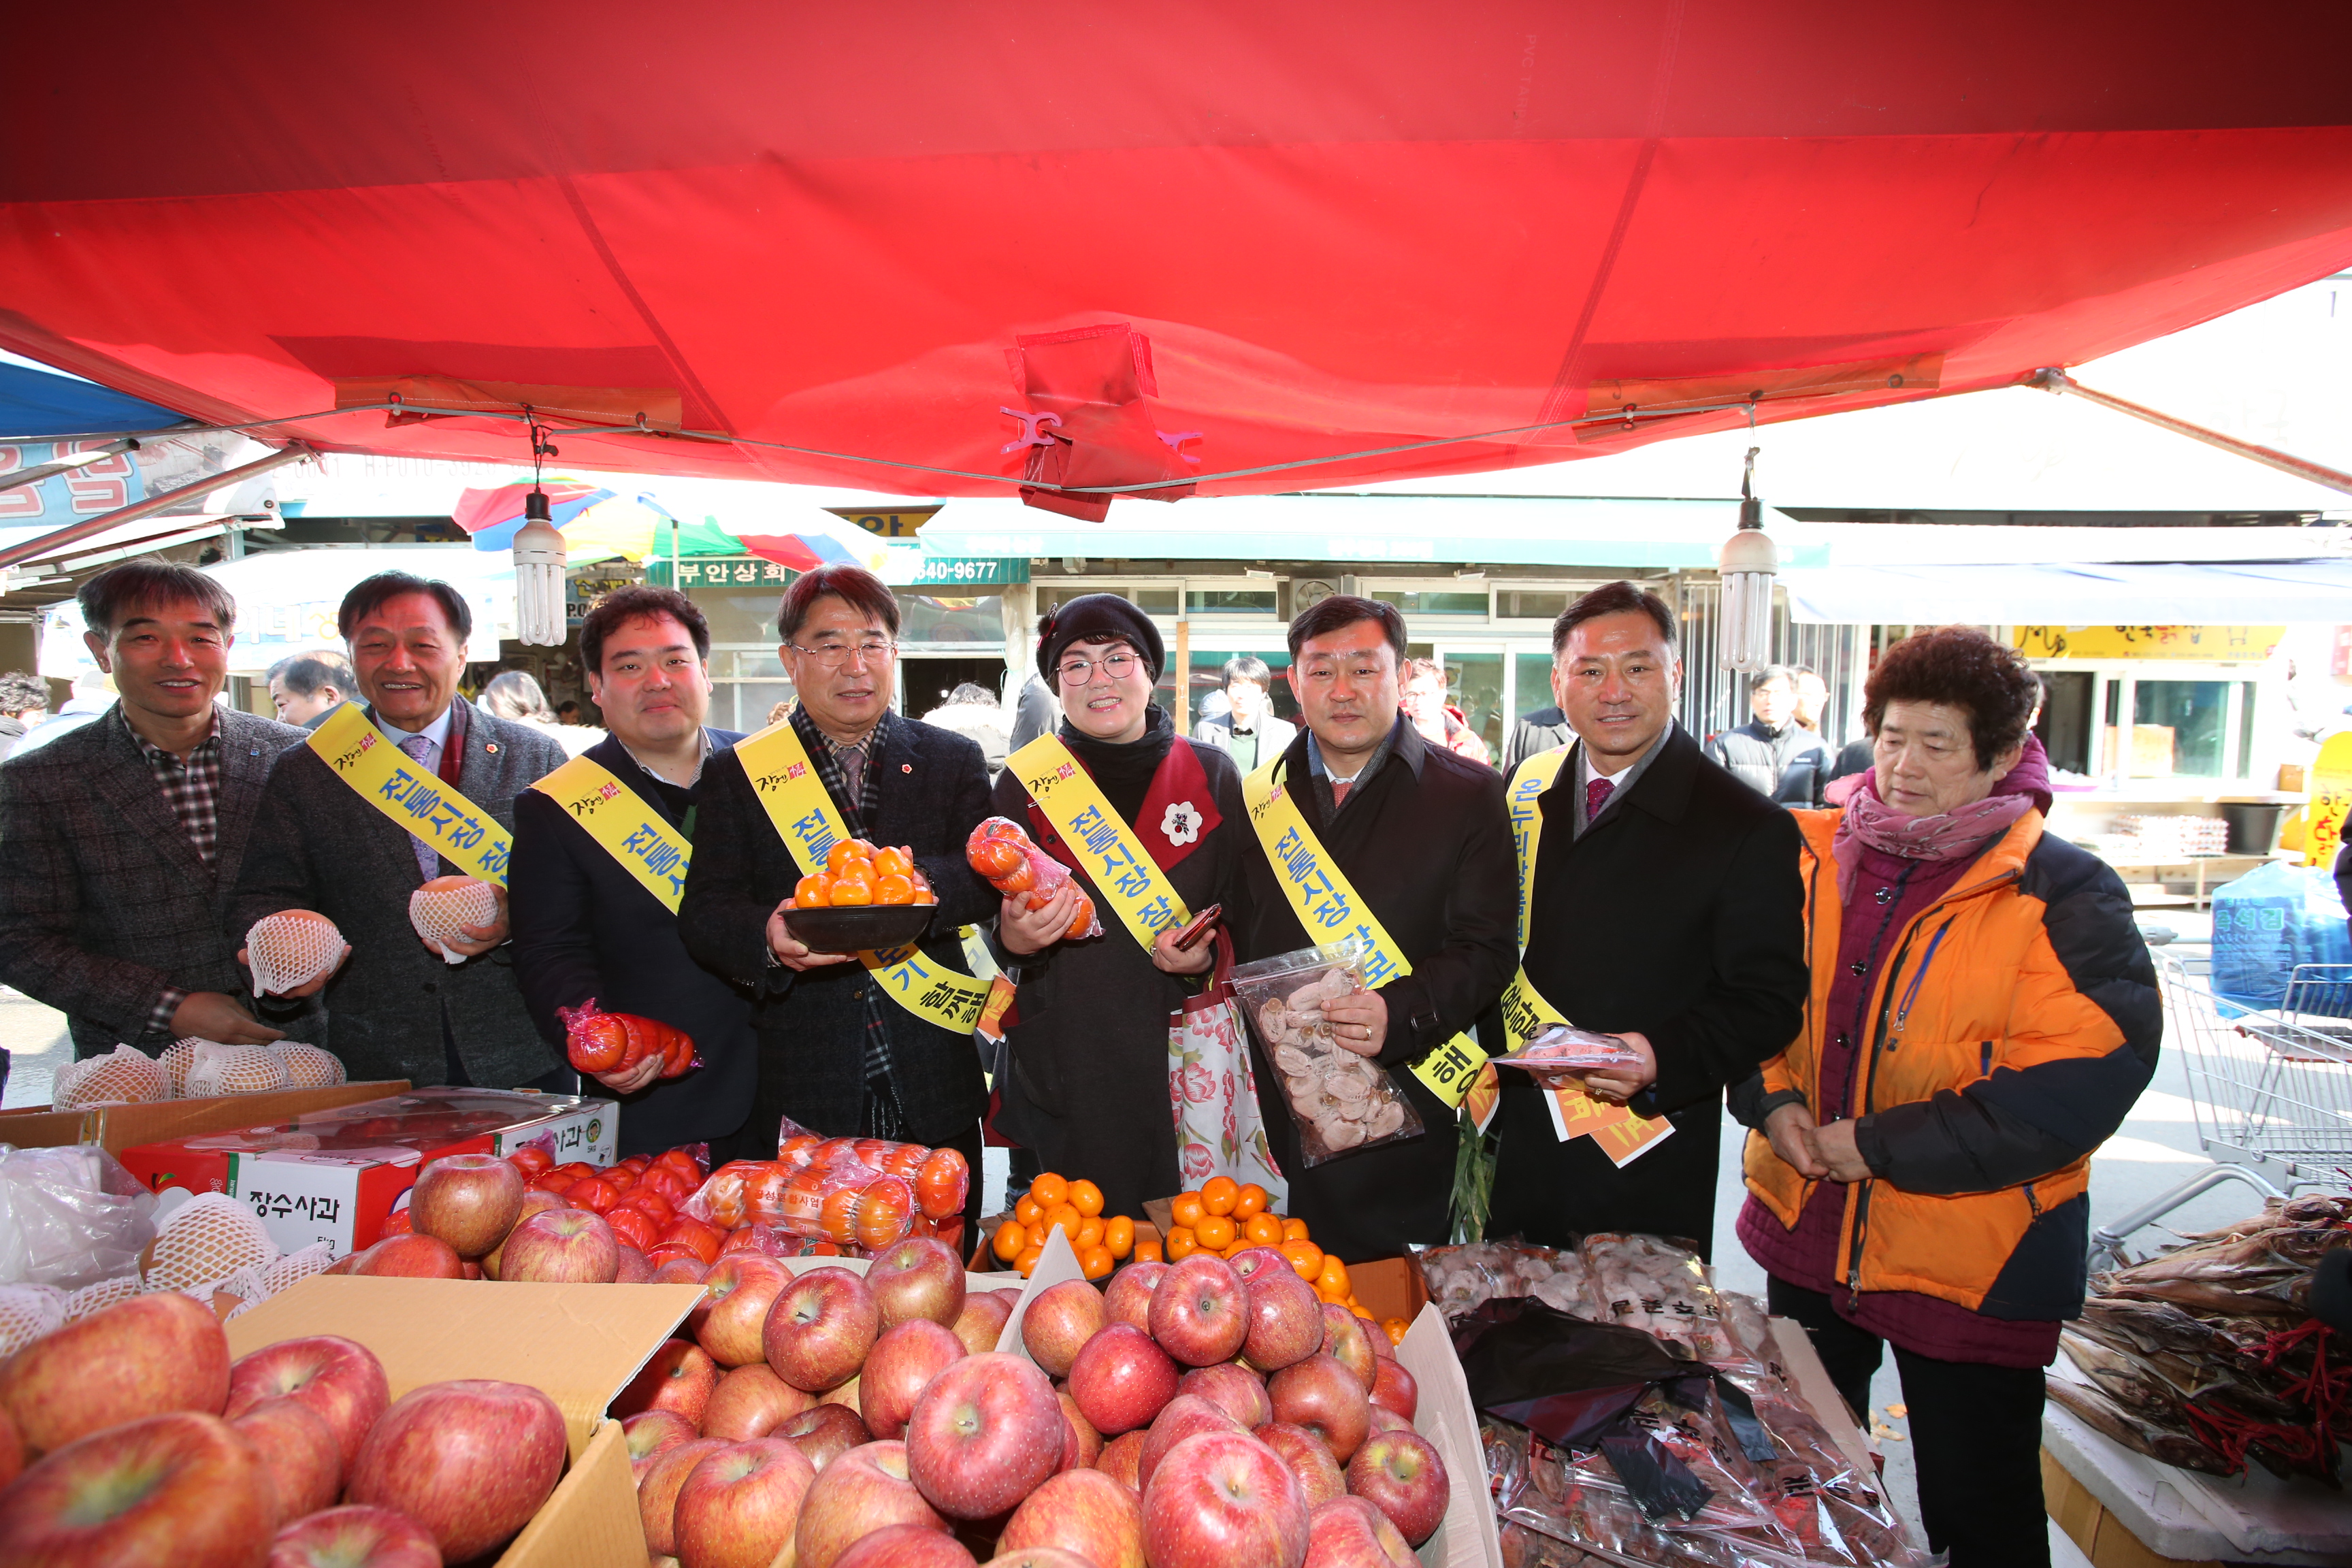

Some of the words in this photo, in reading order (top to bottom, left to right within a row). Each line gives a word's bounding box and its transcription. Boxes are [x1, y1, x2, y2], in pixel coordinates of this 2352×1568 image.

[679, 563, 787, 583] 부안상회
[378, 767, 486, 849] 전통시장
[477, 840, 510, 885] 장
[621, 822, 690, 896] 전통시
[1068, 804, 1152, 898] 전통시장
[791, 807, 843, 872] 전통
[919, 981, 987, 1025] 함께해
[1274, 826, 1351, 928] 전통시장
[249, 1190, 341, 1224] 장수사과
